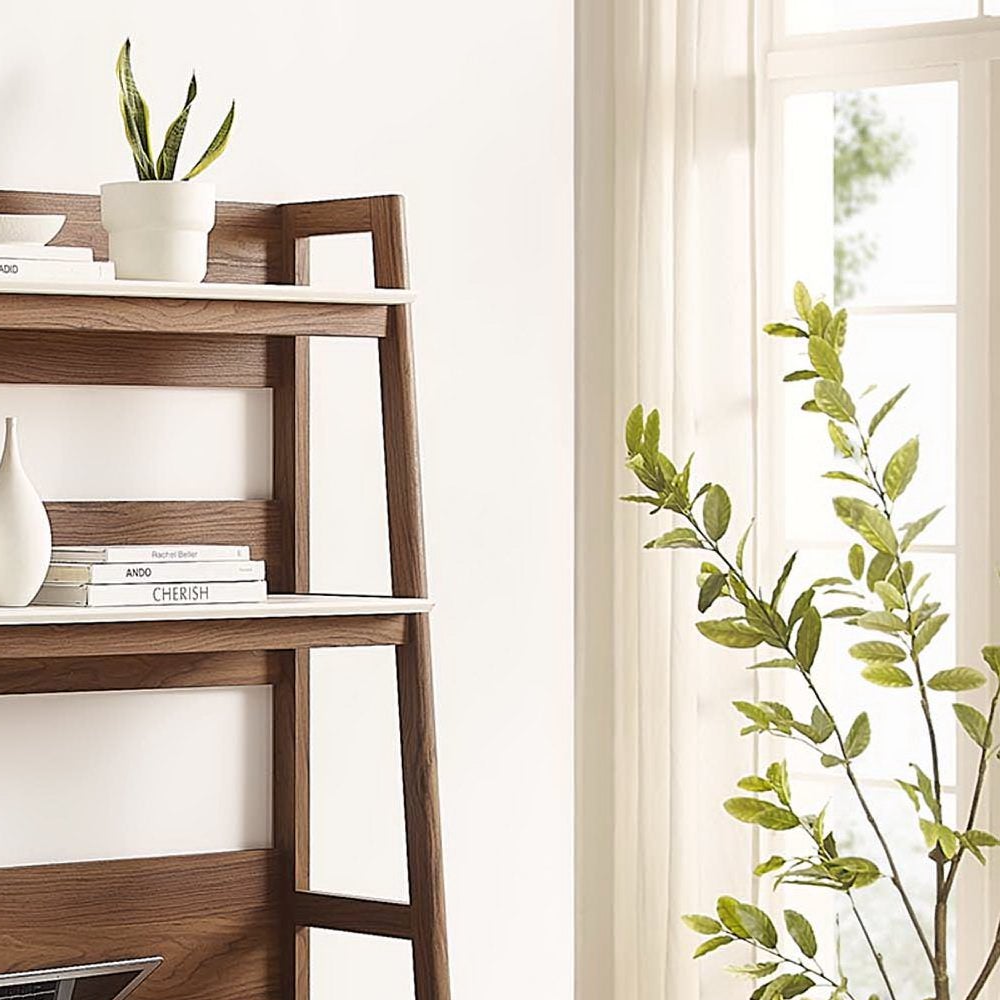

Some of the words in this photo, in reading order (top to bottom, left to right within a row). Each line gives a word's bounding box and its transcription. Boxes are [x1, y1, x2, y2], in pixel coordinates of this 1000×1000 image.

[151, 550, 177, 560] Rachel
[125, 568, 152, 578] ANDO
[152, 586, 209, 602] CHERISH
